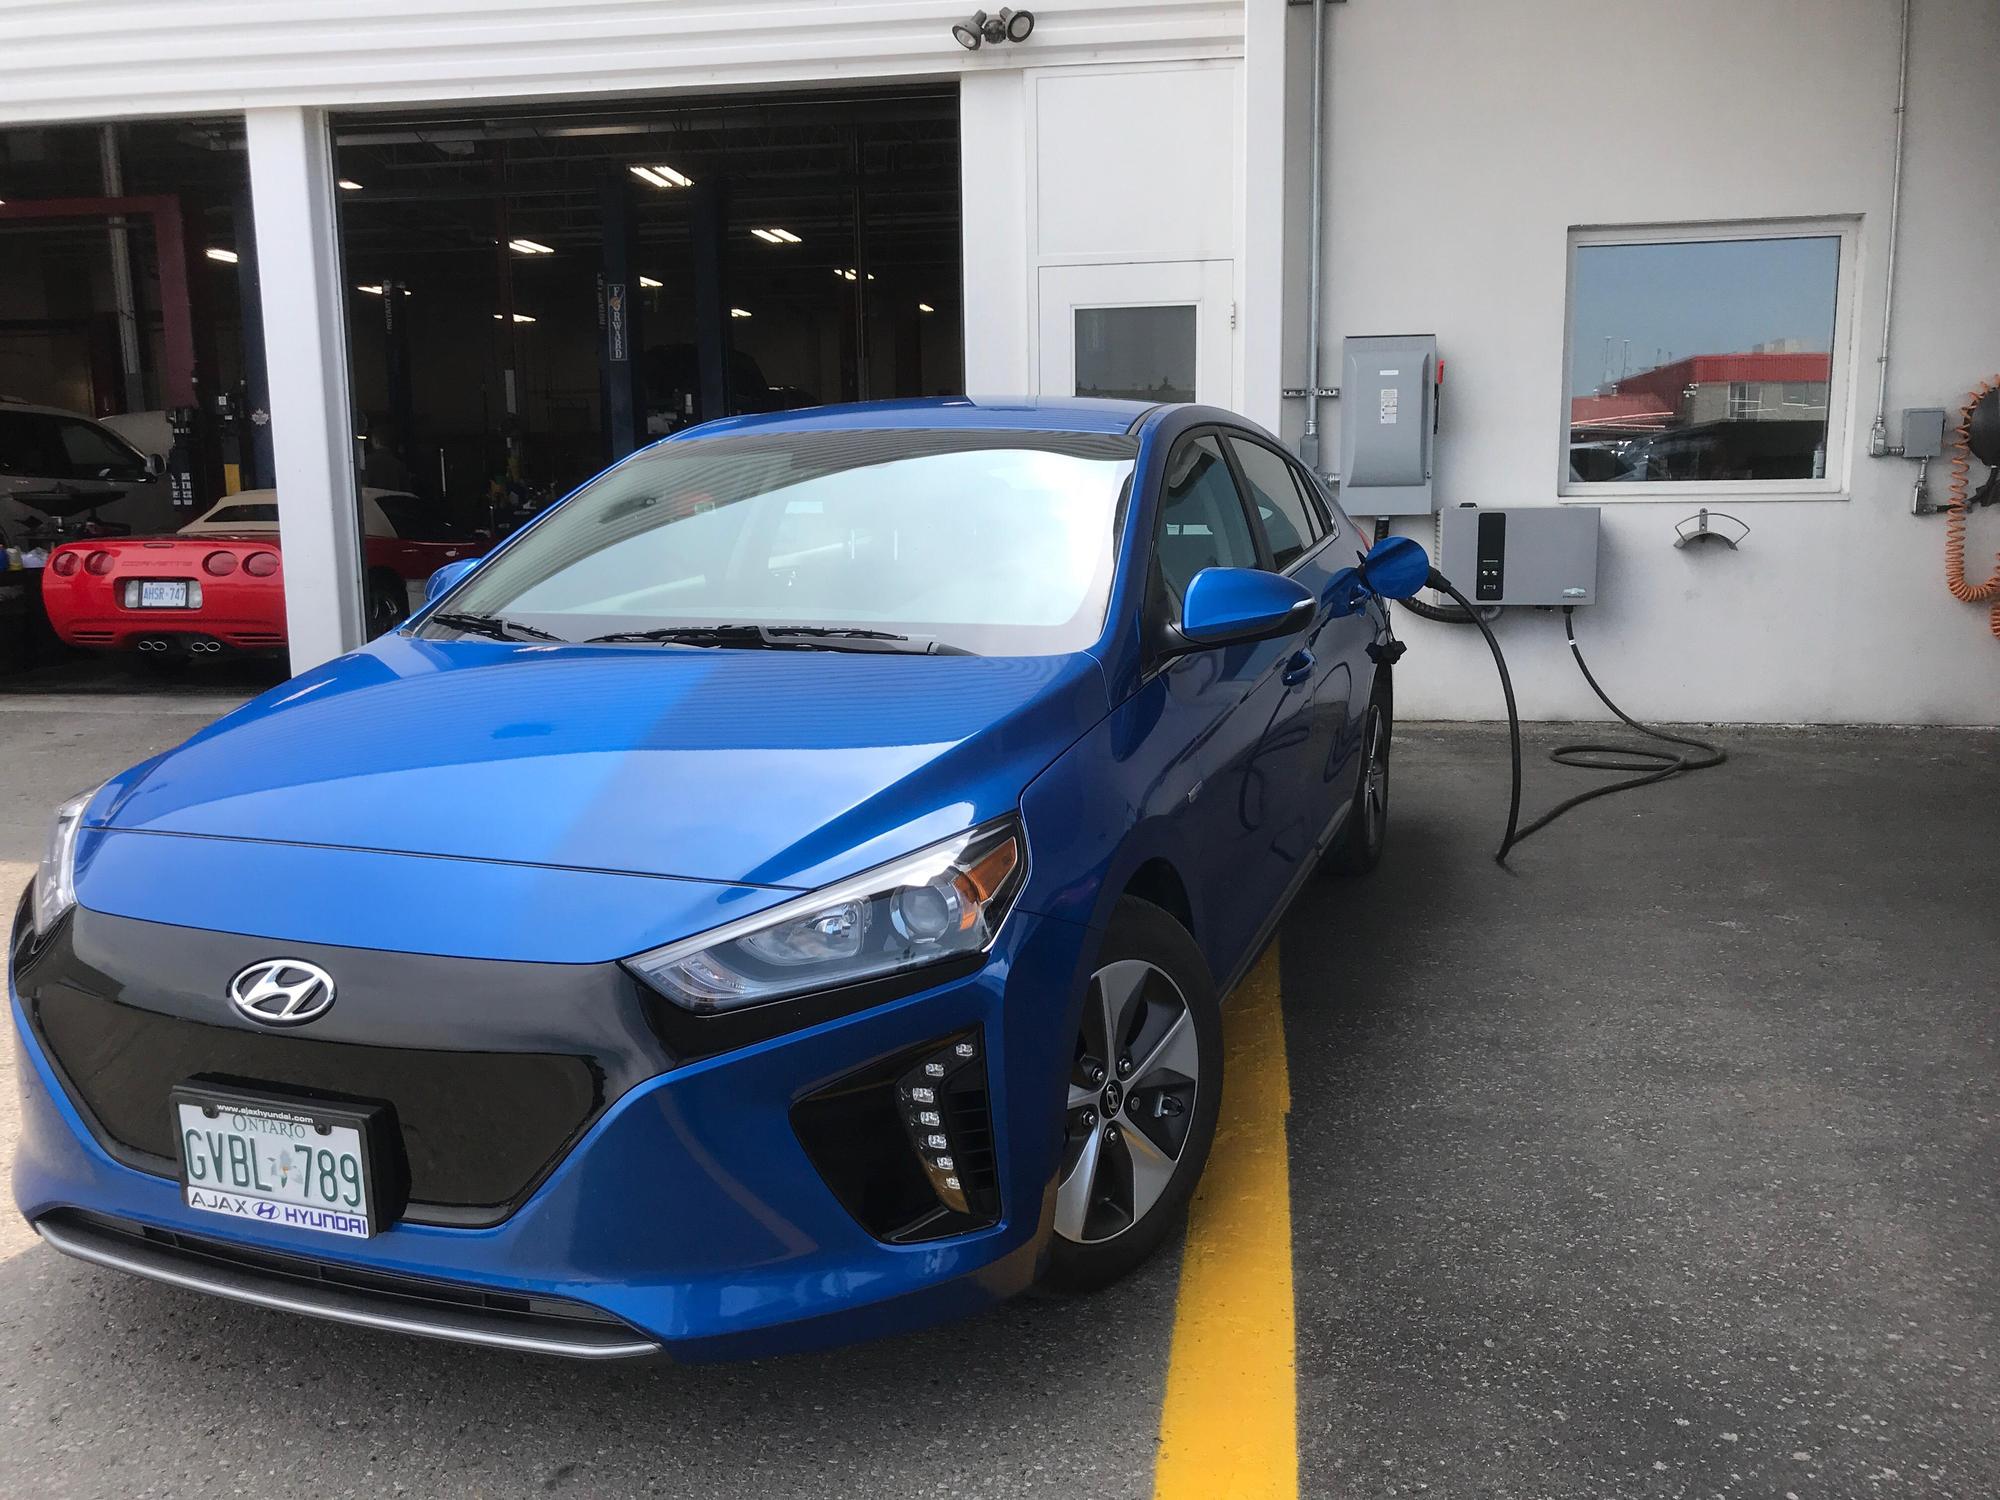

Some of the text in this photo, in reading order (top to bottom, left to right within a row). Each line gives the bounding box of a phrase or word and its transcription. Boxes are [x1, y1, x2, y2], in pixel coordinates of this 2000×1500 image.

[216, 1103, 314, 1124] www.ajaxhyundai.com
[232, 1114, 306, 1139] ONTARIO
[185, 1128, 360, 1207] GVBL 789
[191, 1191, 367, 1235] AJAX HYUNDAI
